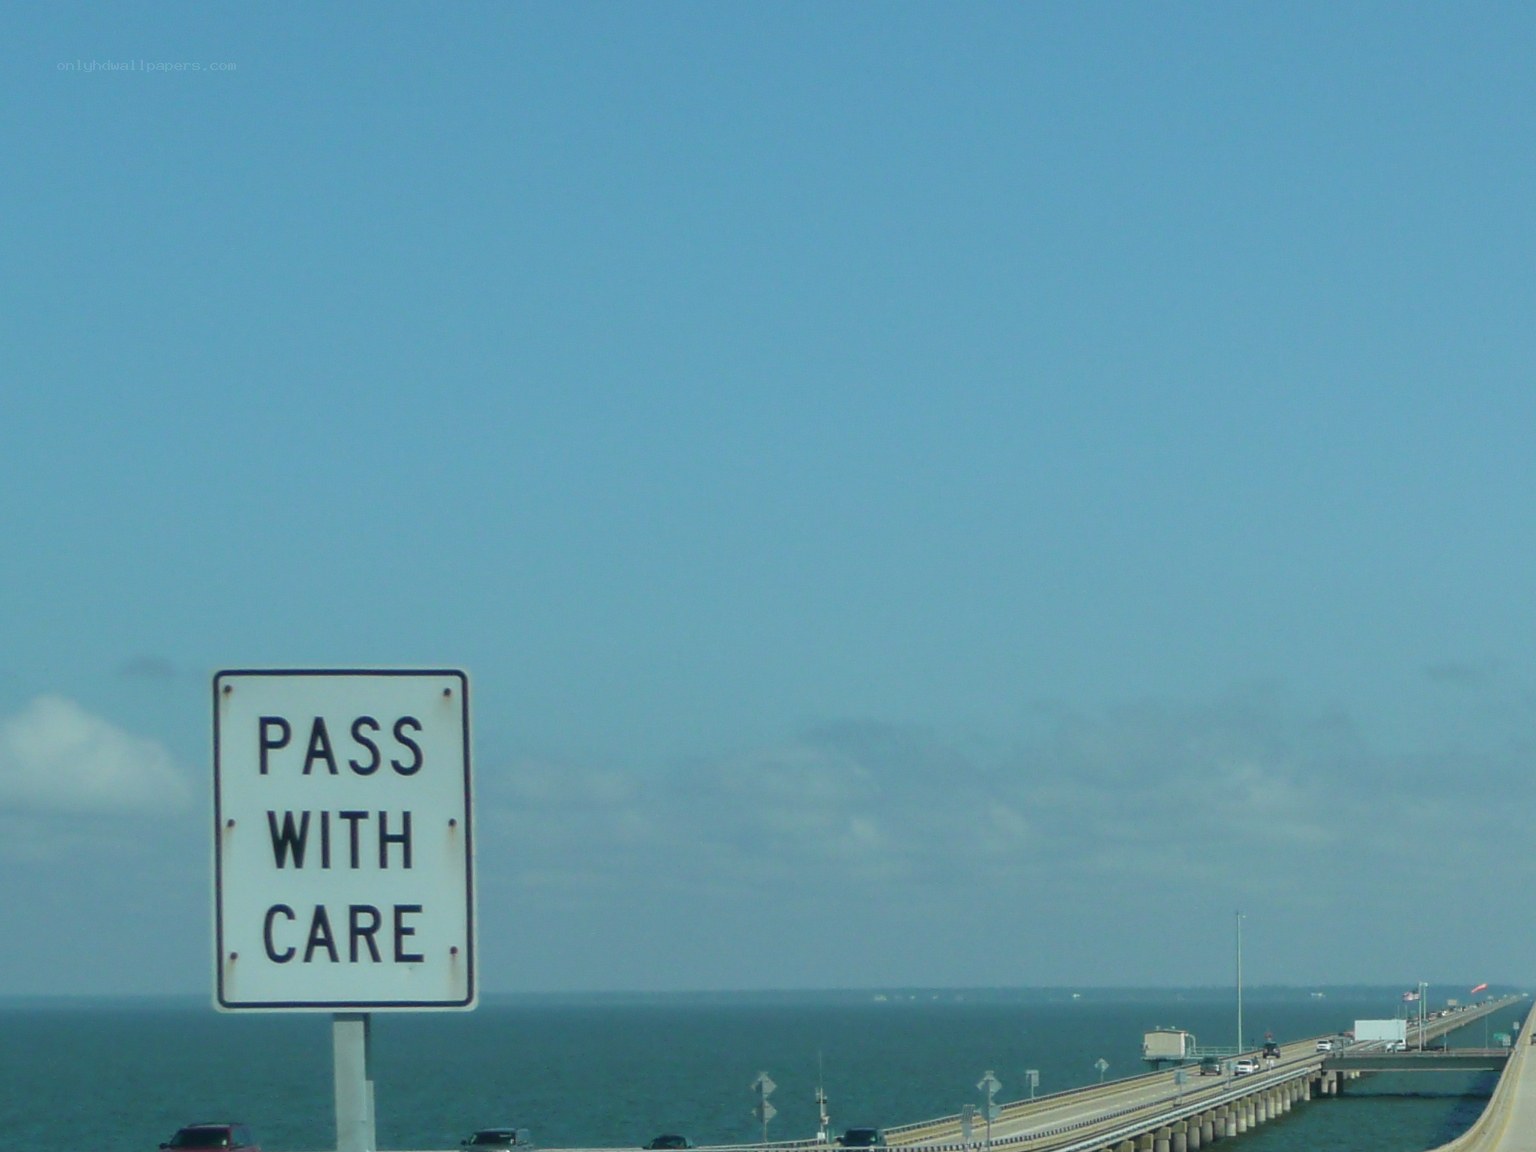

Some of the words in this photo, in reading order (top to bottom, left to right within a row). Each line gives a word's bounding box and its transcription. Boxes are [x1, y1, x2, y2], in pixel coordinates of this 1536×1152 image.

[258, 716, 423, 776] PASS
[267, 811, 412, 869] WITH
[264, 904, 424, 963] CARE
